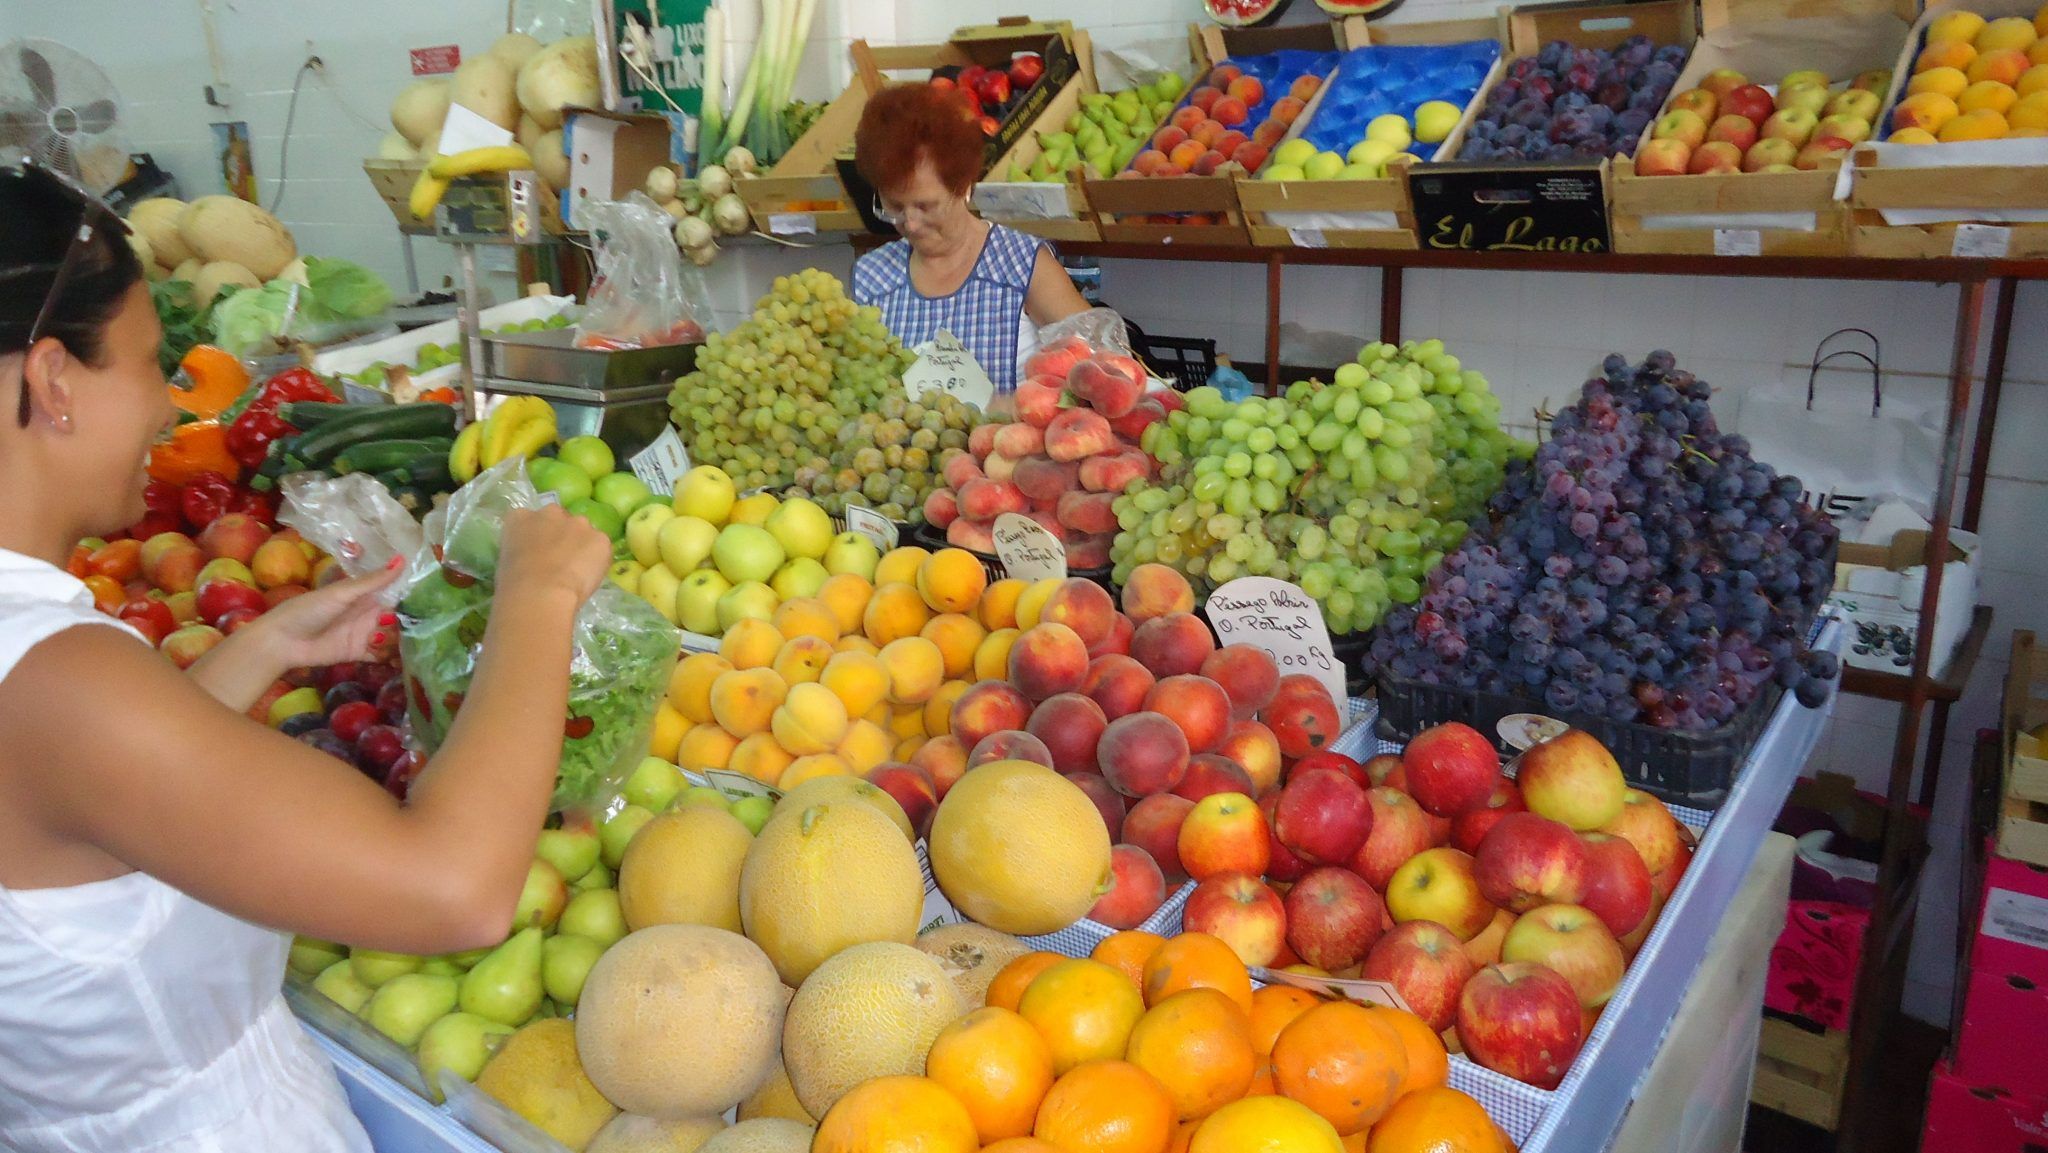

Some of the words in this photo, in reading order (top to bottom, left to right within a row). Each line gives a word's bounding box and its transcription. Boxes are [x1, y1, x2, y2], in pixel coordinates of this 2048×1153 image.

[1429, 214, 1474, 249] El
[1487, 216, 1604, 253] Lago
[1238, 615, 1312, 640] Portugal
